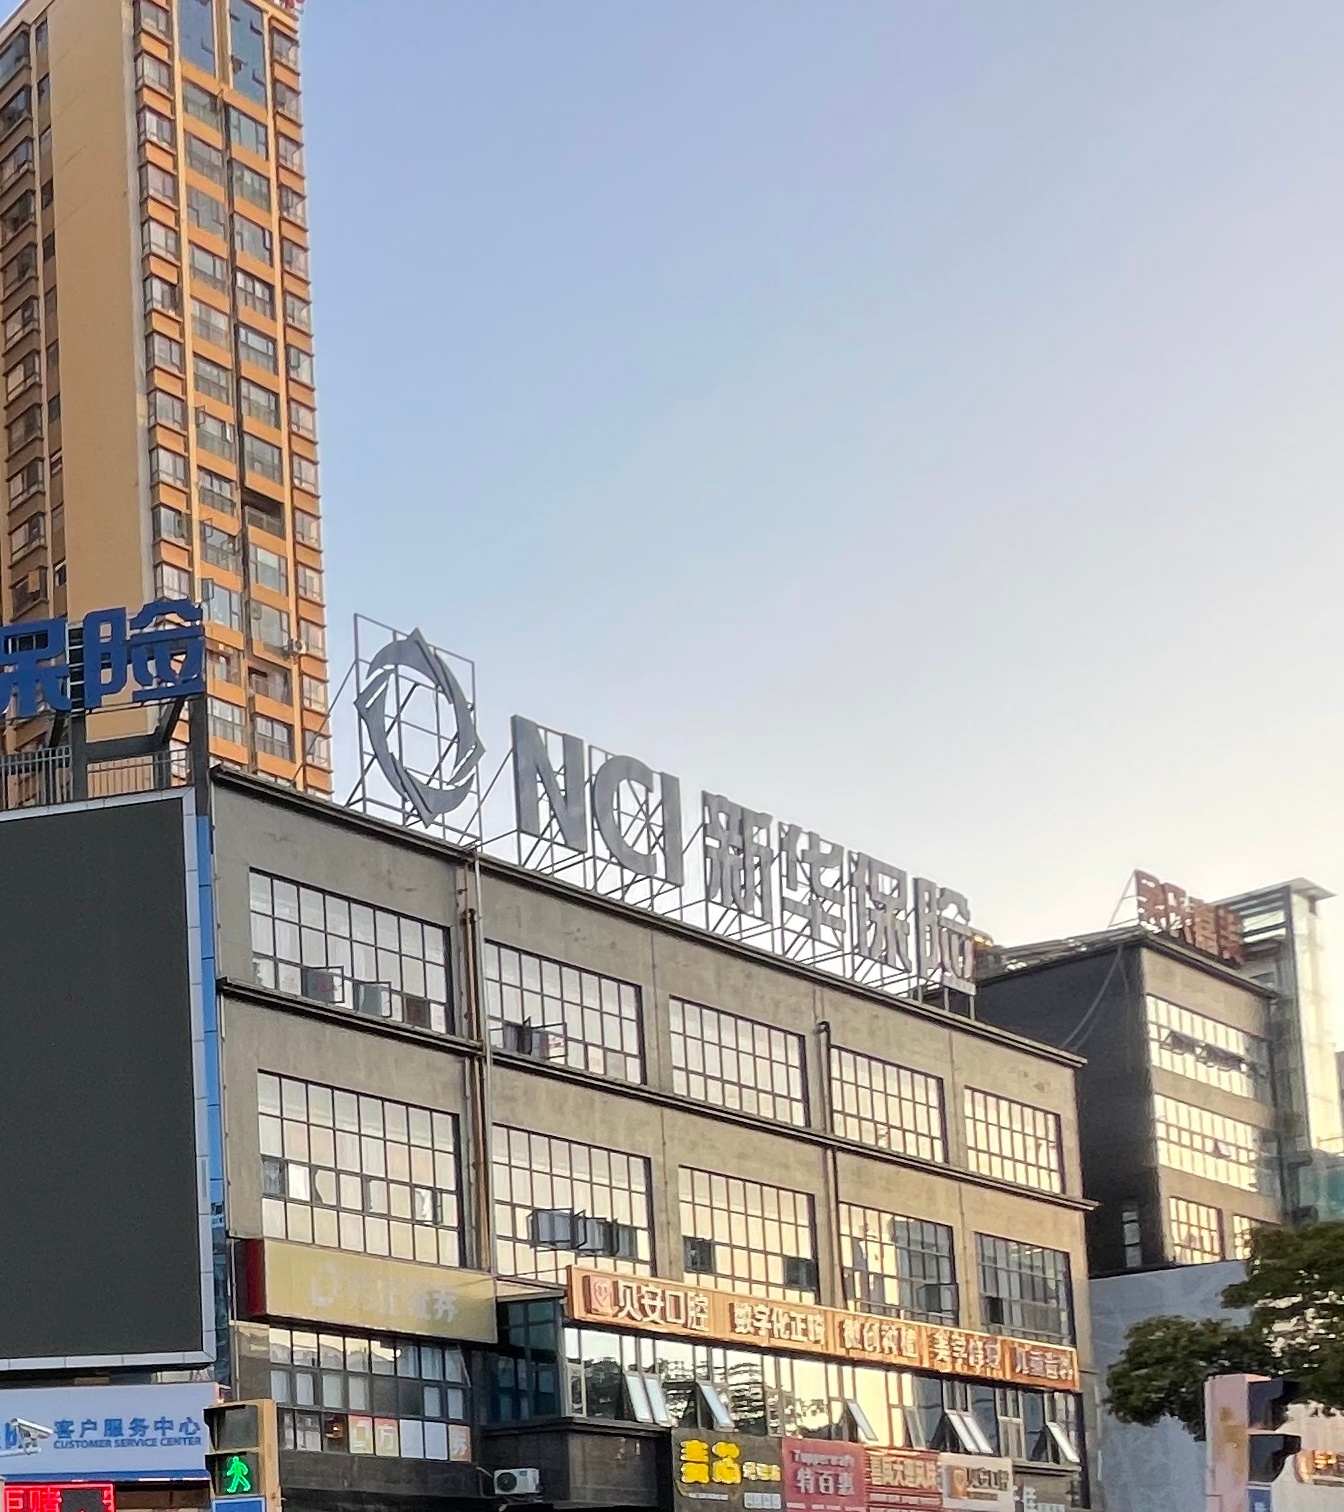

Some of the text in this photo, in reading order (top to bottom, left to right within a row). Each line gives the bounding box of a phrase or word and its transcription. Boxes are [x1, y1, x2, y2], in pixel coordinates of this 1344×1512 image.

[512, 715, 682, 888] NCI
[701, 791, 977, 994] 新华保险
[617, 1279, 710, 1332] 贝安口腔
[53, 1415, 201, 1440] 客户服务中心
[53, 1435, 202, 1449] CUSTOMER SERVICE CENTER
